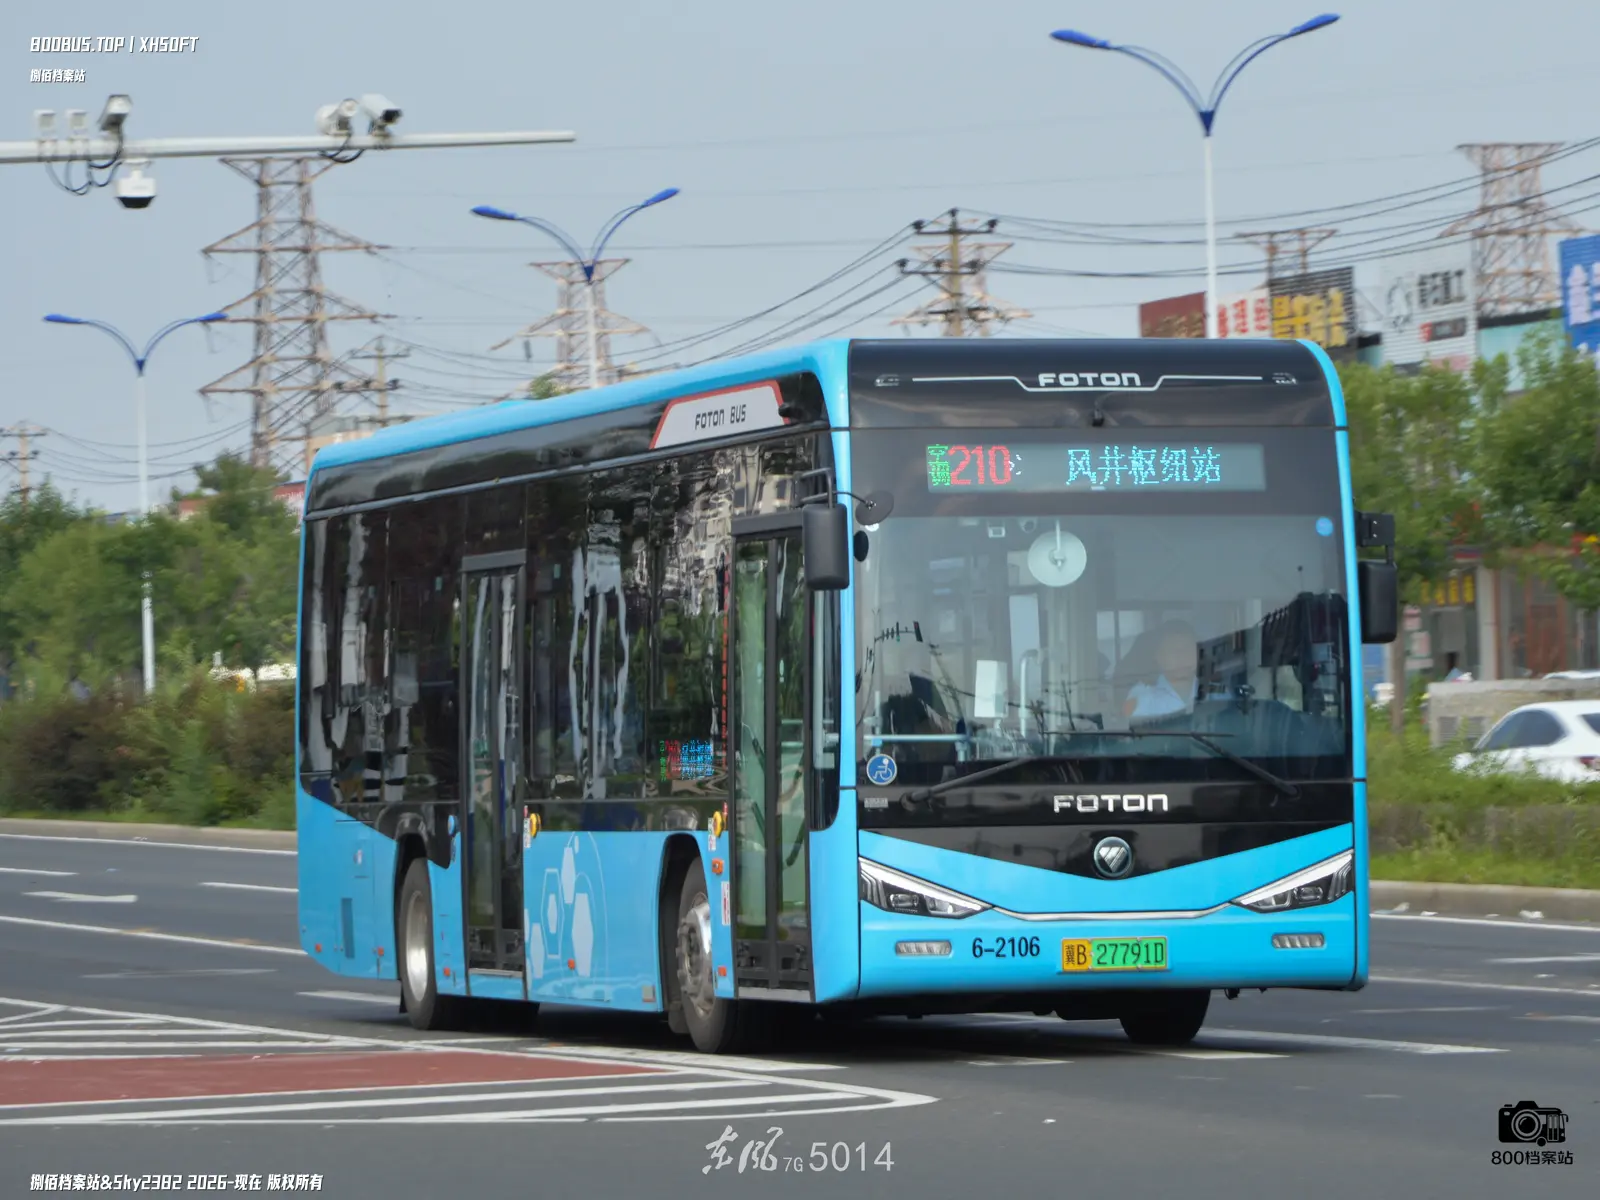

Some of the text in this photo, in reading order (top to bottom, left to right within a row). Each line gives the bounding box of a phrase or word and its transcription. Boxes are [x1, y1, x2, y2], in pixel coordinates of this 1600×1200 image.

[1038, 372, 1141, 388] FOTON
[695, 404, 747, 430] FOTON BUS
[948, 445, 1012, 485] 210
[1066, 445, 1221, 486] 风井枢纽站
[1053, 794, 1169, 813] FOTON
[971, 936, 1041, 958] 6-2106
